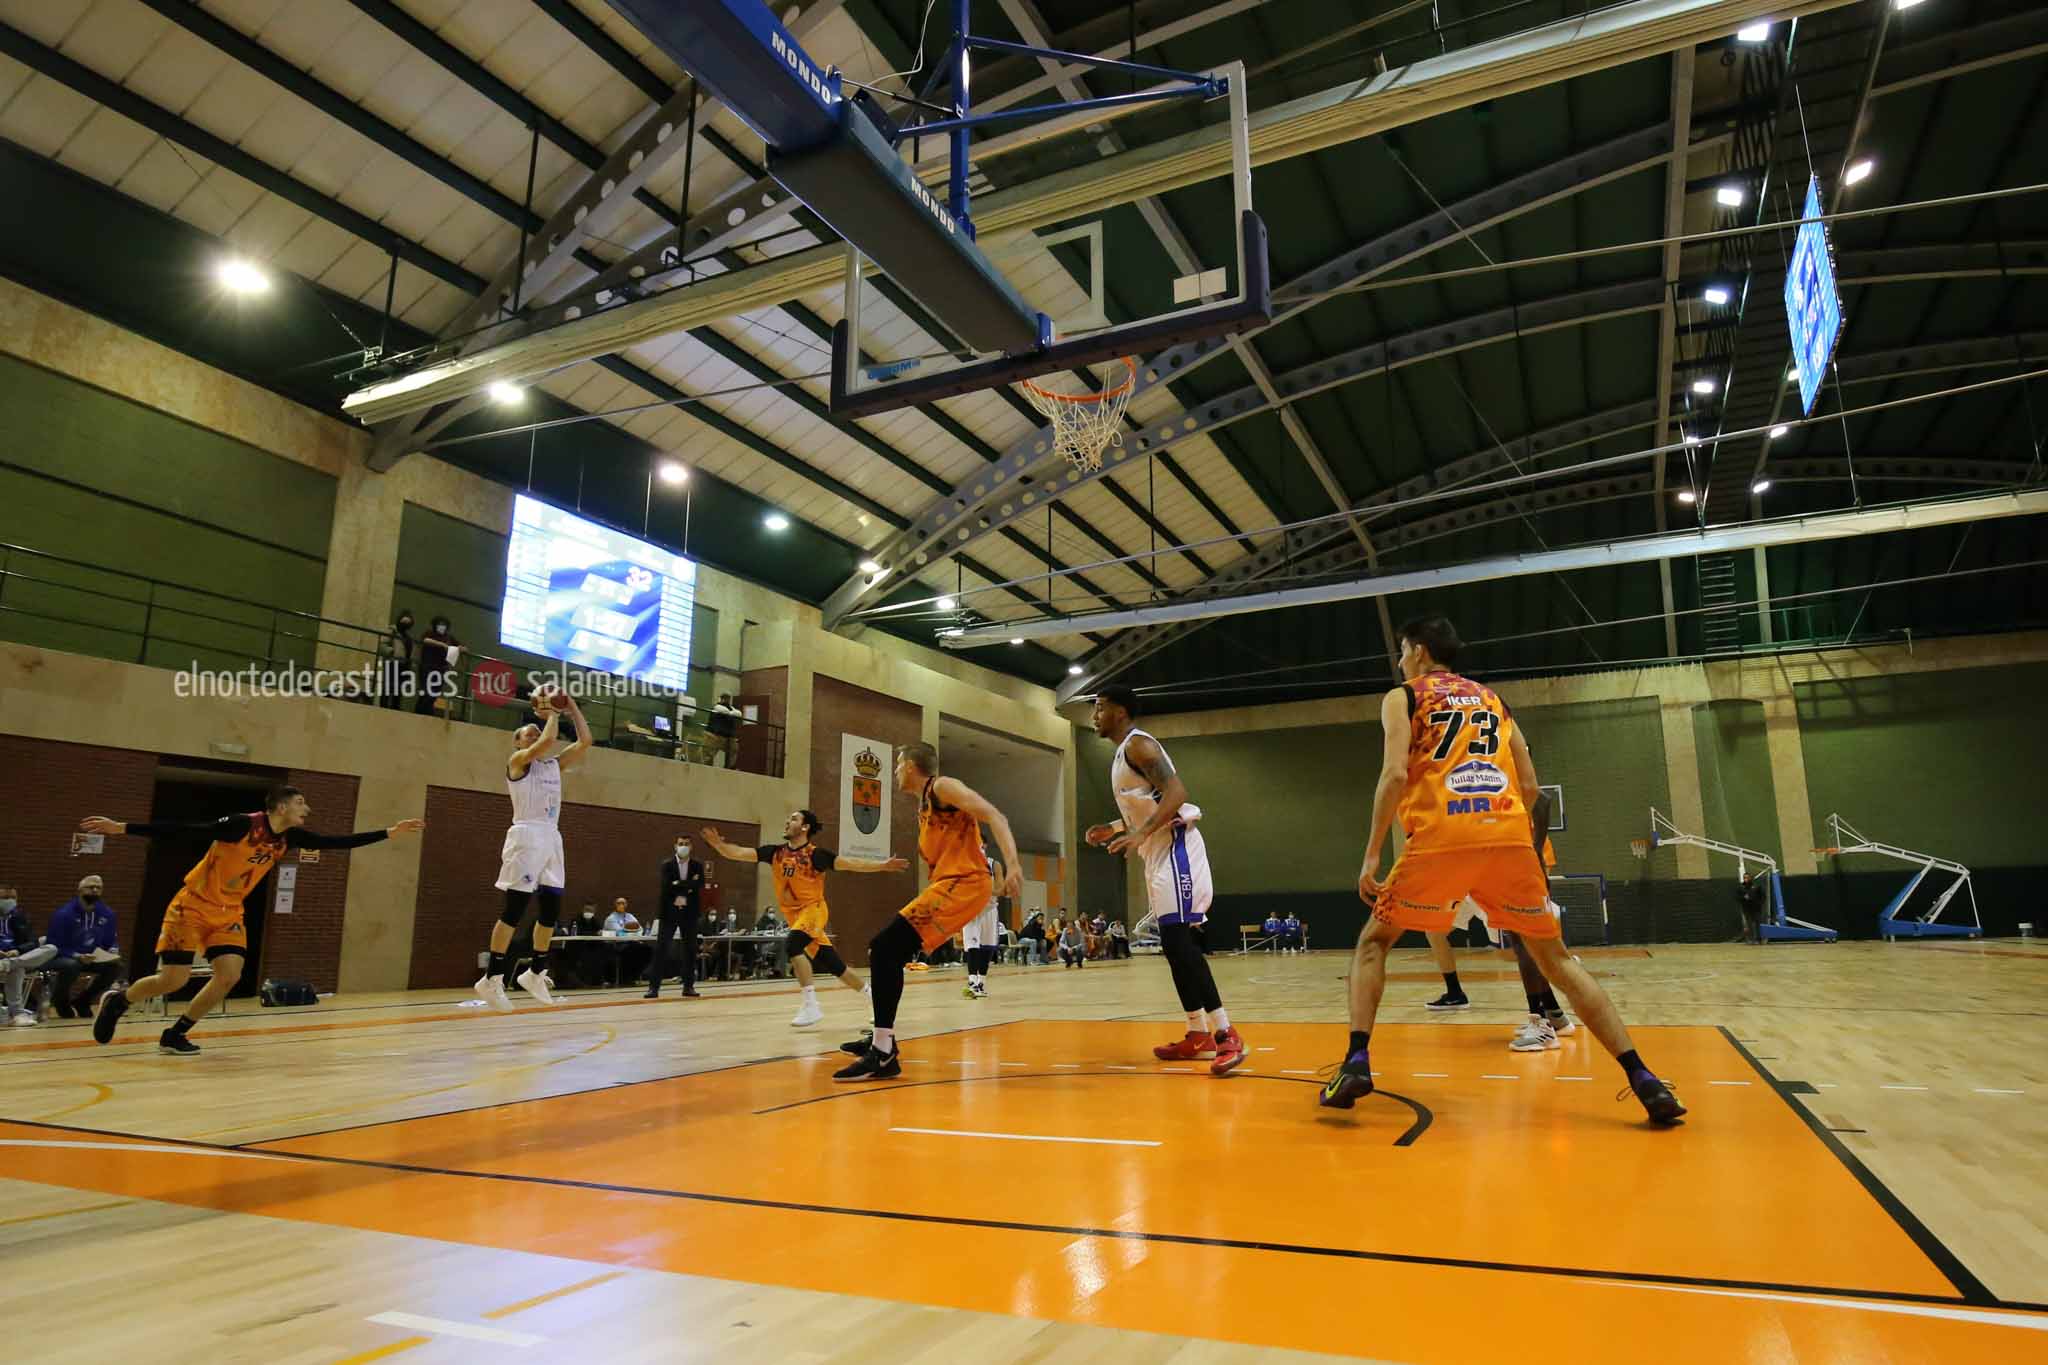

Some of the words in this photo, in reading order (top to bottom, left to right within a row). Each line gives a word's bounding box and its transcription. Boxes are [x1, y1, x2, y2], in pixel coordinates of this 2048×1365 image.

[772, 31, 832, 105] MONDO
[911, 176, 955, 234] MONDO
[1447, 695, 1482, 706] IKER
[1429, 710, 1501, 762] 73
[1447, 797, 1513, 816] MRW
[1181, 873, 1192, 900] CBM
